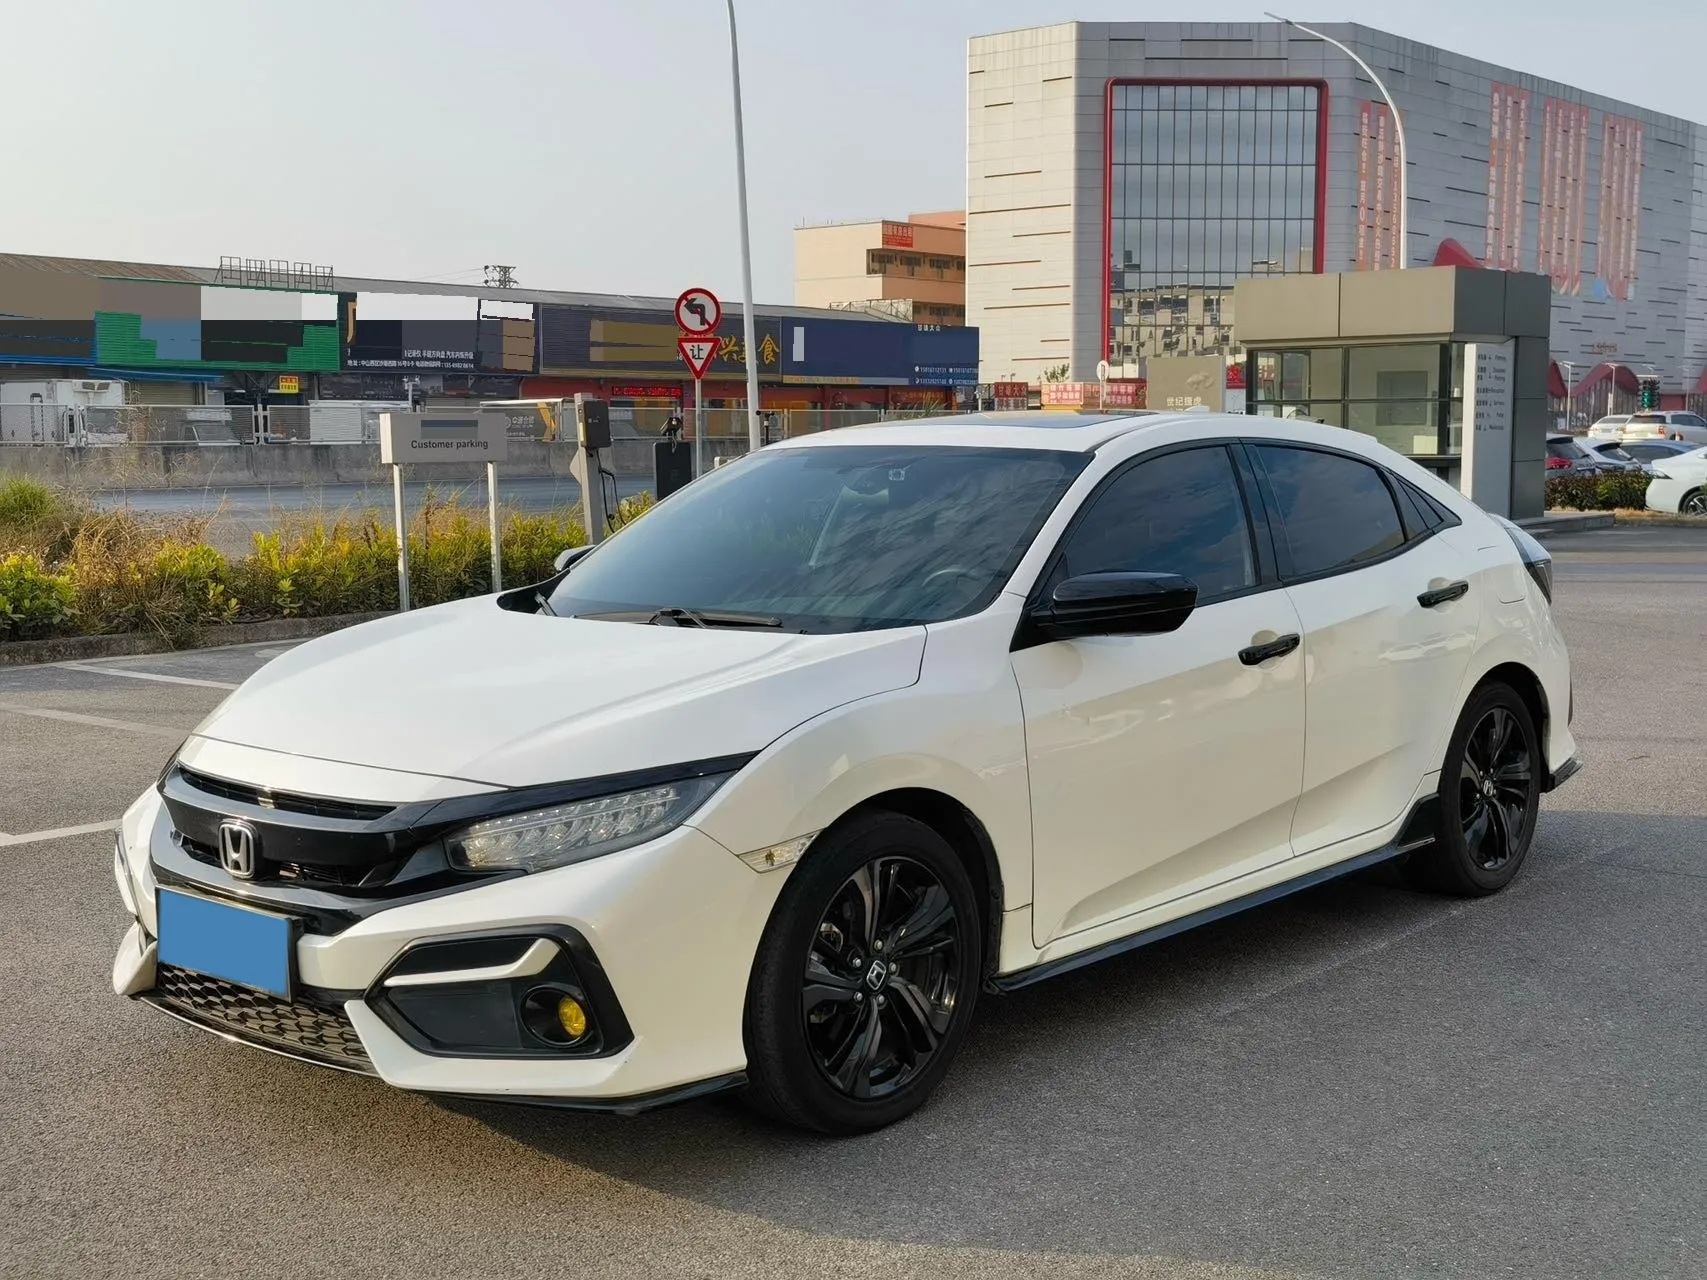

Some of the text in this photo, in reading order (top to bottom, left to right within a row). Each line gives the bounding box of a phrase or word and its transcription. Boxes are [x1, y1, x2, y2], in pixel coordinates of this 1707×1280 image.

[690, 344, 704, 360] 让
[411, 440, 489, 450] Customer parking
